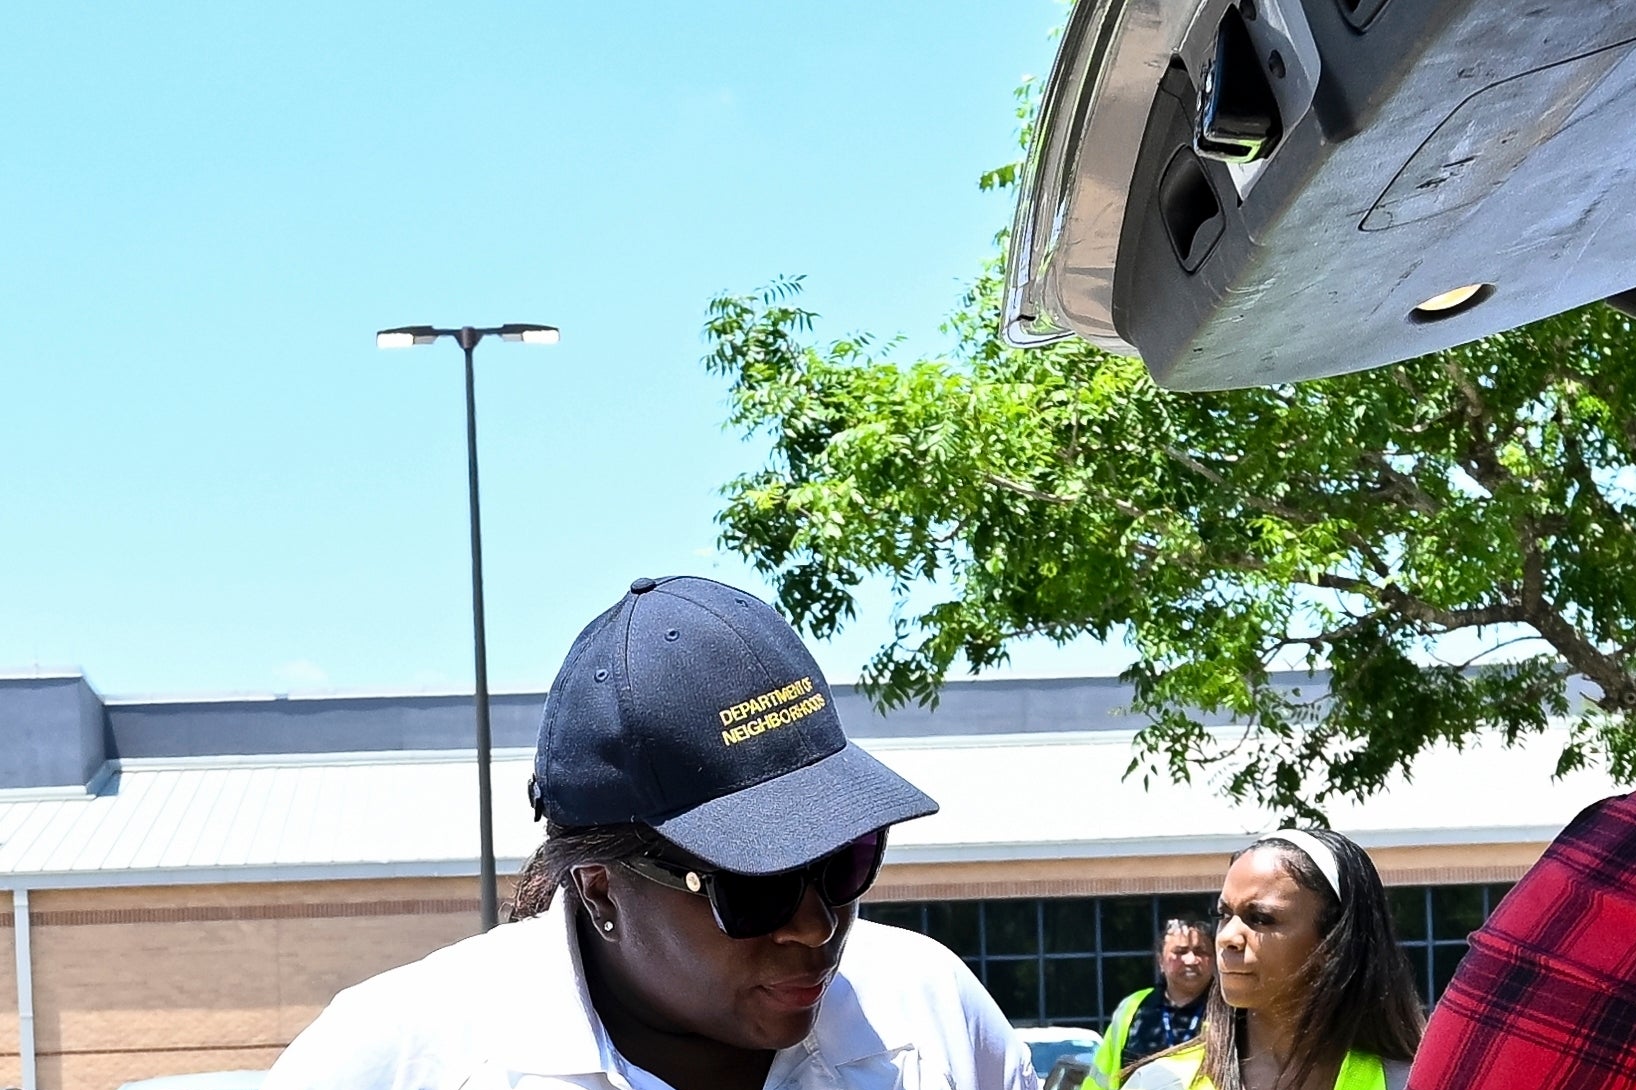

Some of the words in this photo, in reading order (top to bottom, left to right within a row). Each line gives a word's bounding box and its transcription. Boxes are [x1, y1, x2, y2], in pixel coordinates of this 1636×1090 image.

[719, 679, 803, 727] DEPARTMENT
[801, 676, 813, 693] OF
[721, 693, 826, 746] NEIGHBORHOODS
